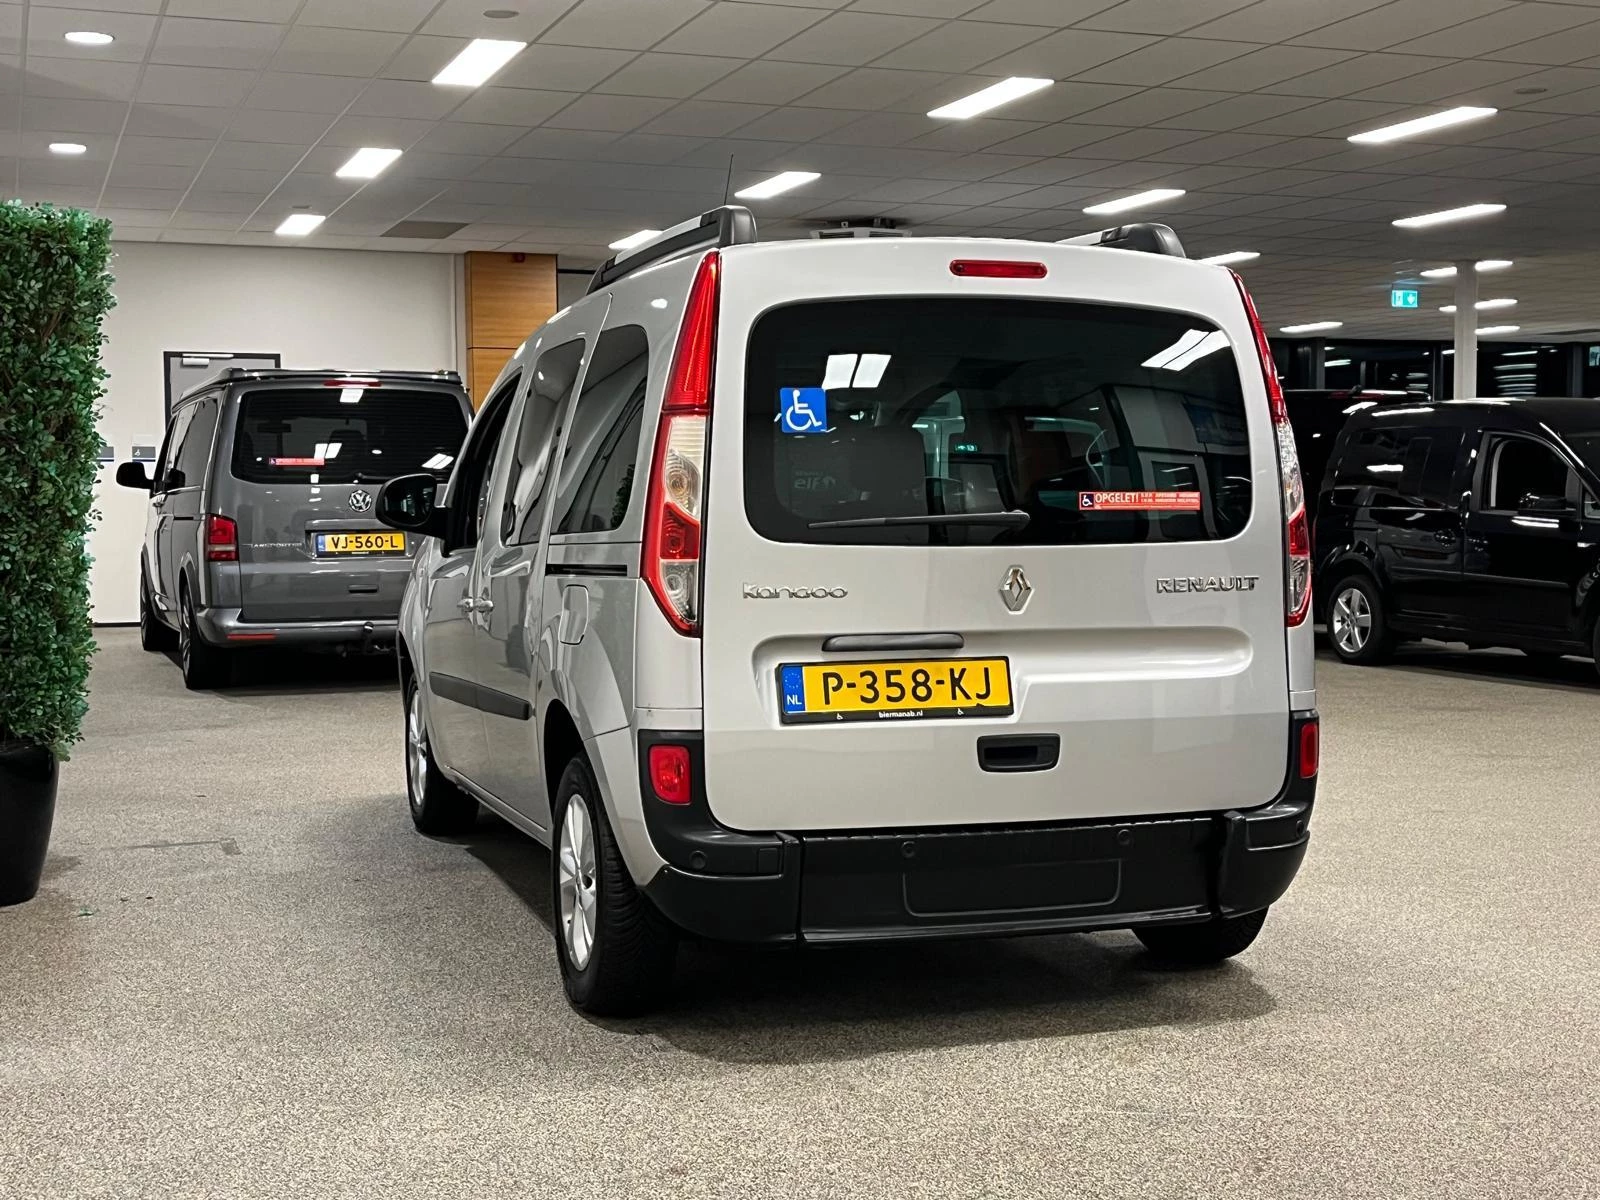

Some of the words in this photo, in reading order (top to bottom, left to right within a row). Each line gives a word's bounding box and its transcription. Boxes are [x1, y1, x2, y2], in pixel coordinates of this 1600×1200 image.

[1095, 492, 1139, 503] OPGELET!
[331, 535, 398, 549] VJ-560-L
[743, 582, 848, 599] Kangoo
[1156, 575, 1259, 593] RENAULT
[822, 667, 991, 706] P-358-KJ
[787, 694, 802, 706] NL
[878, 710, 924, 718] biermanab.nl
